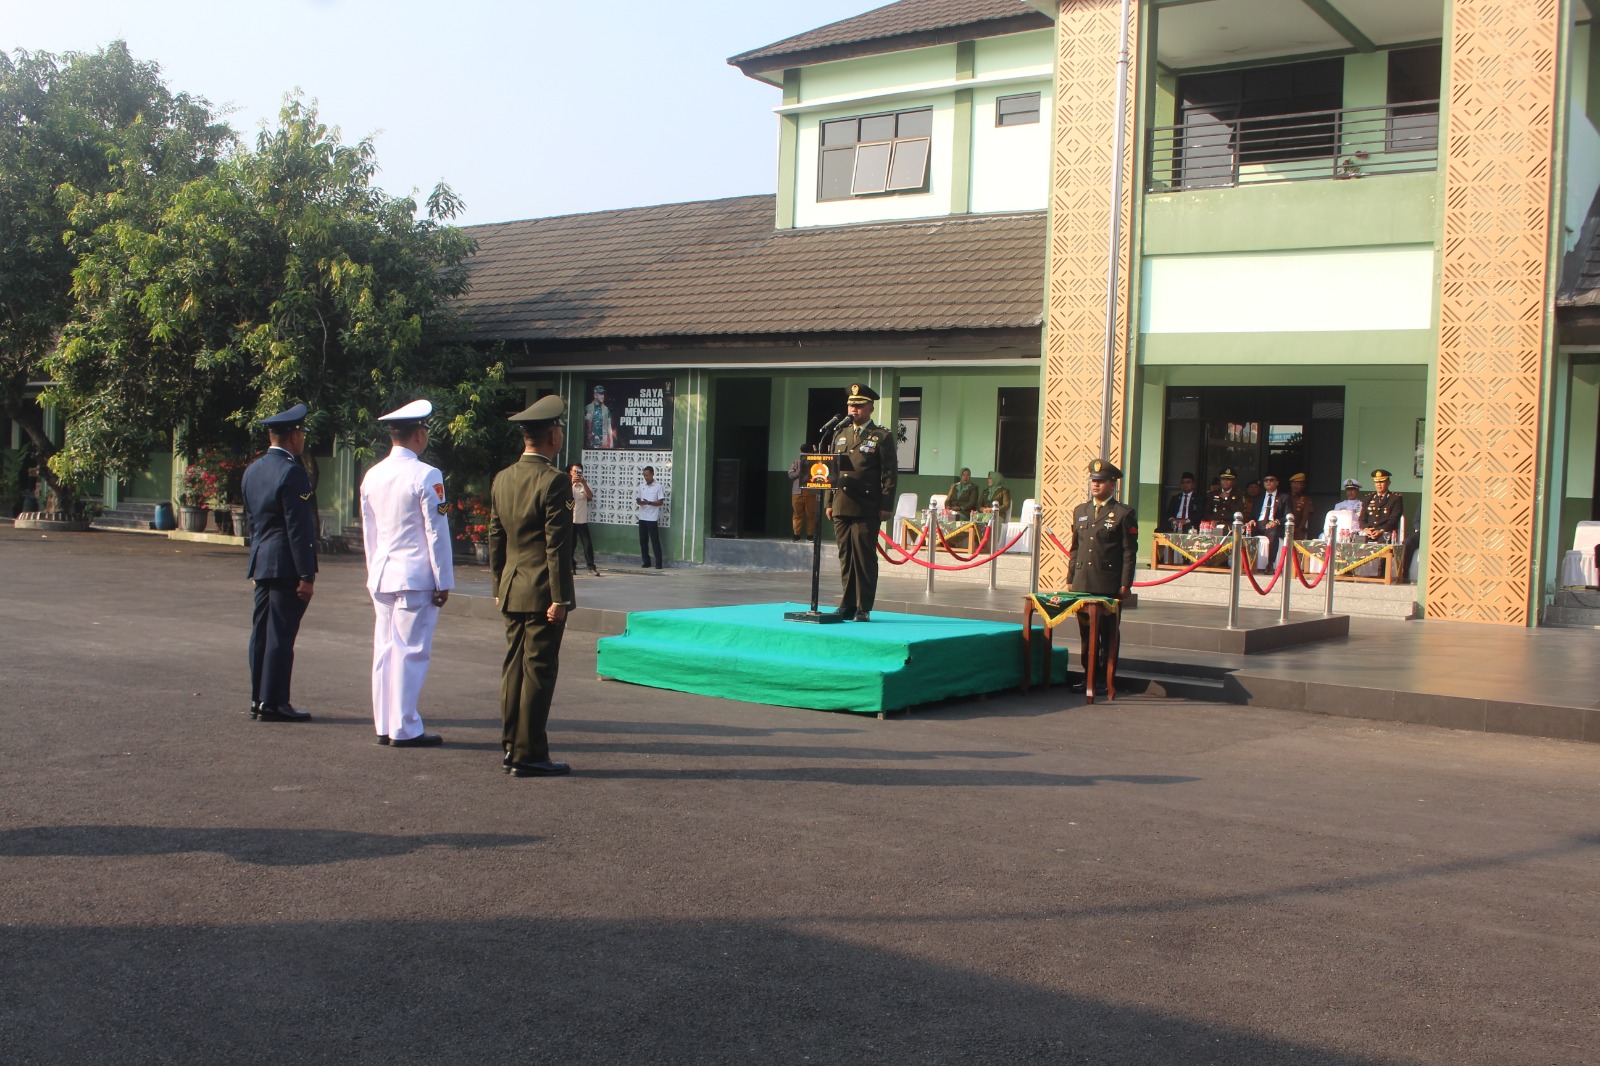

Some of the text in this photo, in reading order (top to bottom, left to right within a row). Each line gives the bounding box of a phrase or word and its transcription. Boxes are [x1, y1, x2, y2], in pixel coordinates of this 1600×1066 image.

[640, 388, 663, 398] SAYA
[628, 398, 663, 408] BANGGA
[624, 408, 664, 416] MENJADI
[620, 416, 663, 426] PRAJURIT
[634, 426, 662, 436] TNI AD
